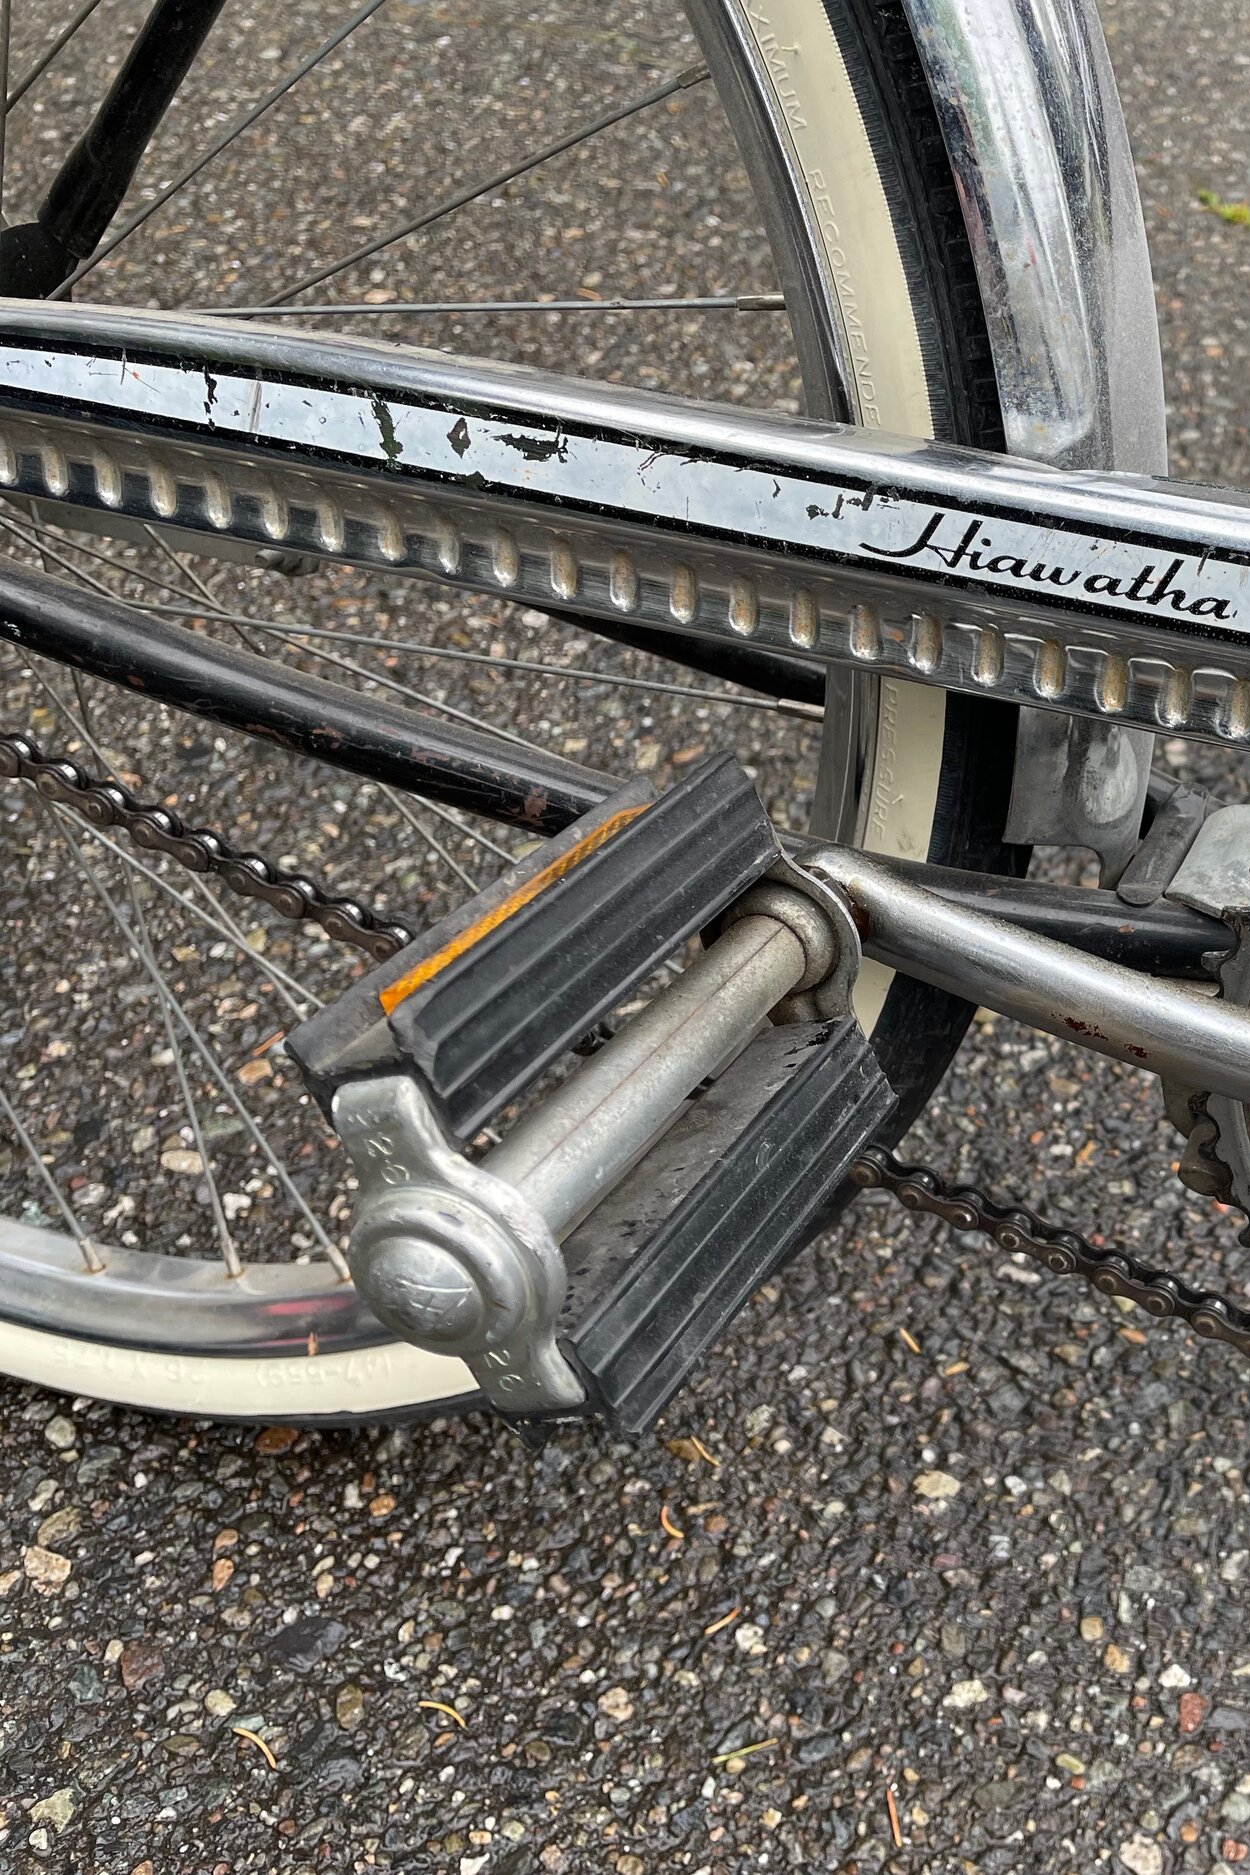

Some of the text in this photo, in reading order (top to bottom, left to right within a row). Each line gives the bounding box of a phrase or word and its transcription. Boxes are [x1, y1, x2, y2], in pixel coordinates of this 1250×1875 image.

[807, 168, 881, 431] RECOMMENDE
[859, 512, 1231, 620] Hiawatha
[871, 683, 899, 840] PRESSURE
